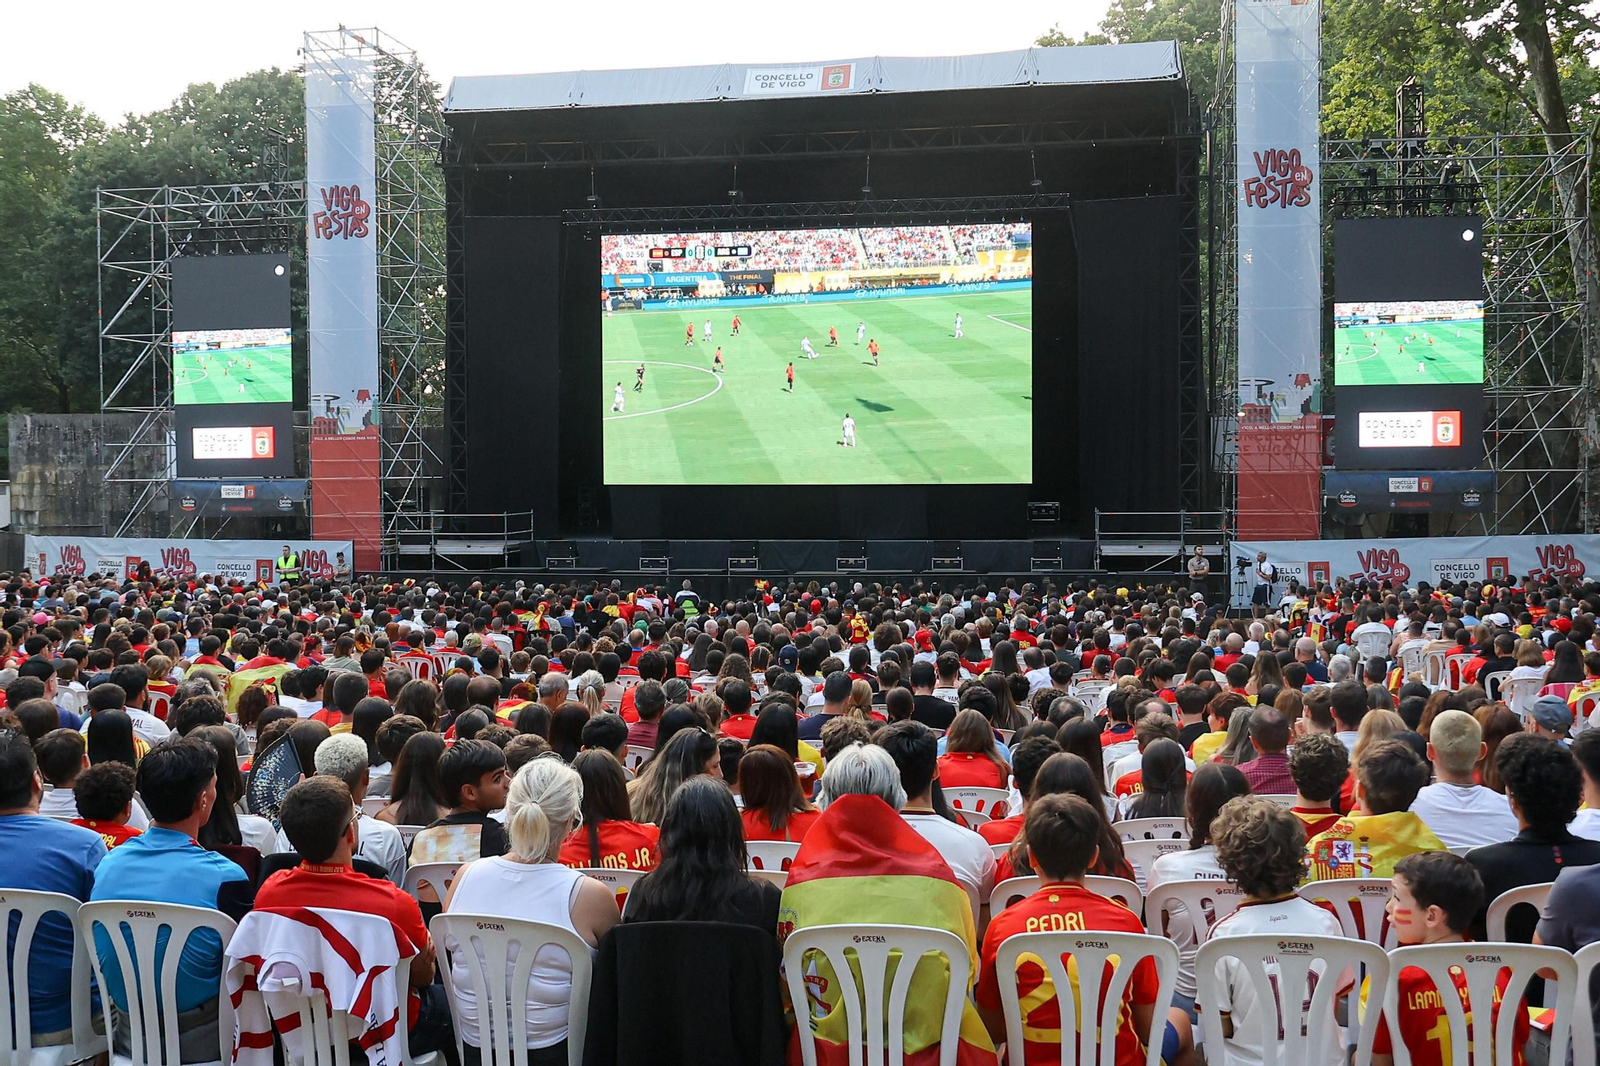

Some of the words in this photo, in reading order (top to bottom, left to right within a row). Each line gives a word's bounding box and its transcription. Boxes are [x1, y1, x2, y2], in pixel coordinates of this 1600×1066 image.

[755, 73, 814, 82] CONCELLO
[1252, 148, 1301, 177] VIGO
[320, 184, 360, 211] VIGO
[665, 275, 708, 284] ARGENTINA
[682, 298, 720, 306] HYUNDAI
[869, 288, 906, 296] HYUNDAI
[1365, 419, 1423, 428] CONCELLO
[1372, 430, 1386, 439] DE
[1390, 430, 1415, 438] VIGO
[60, 544, 81, 565] VIGO
[160, 547, 190, 569] VIGO
[294, 549, 328, 572] VIGO
[1357, 548, 1400, 573] VIGO
[1535, 544, 1575, 569] VIGO
[1434, 563, 1480, 571] CONCELLO
[1025, 911, 1086, 933] PEDRI
